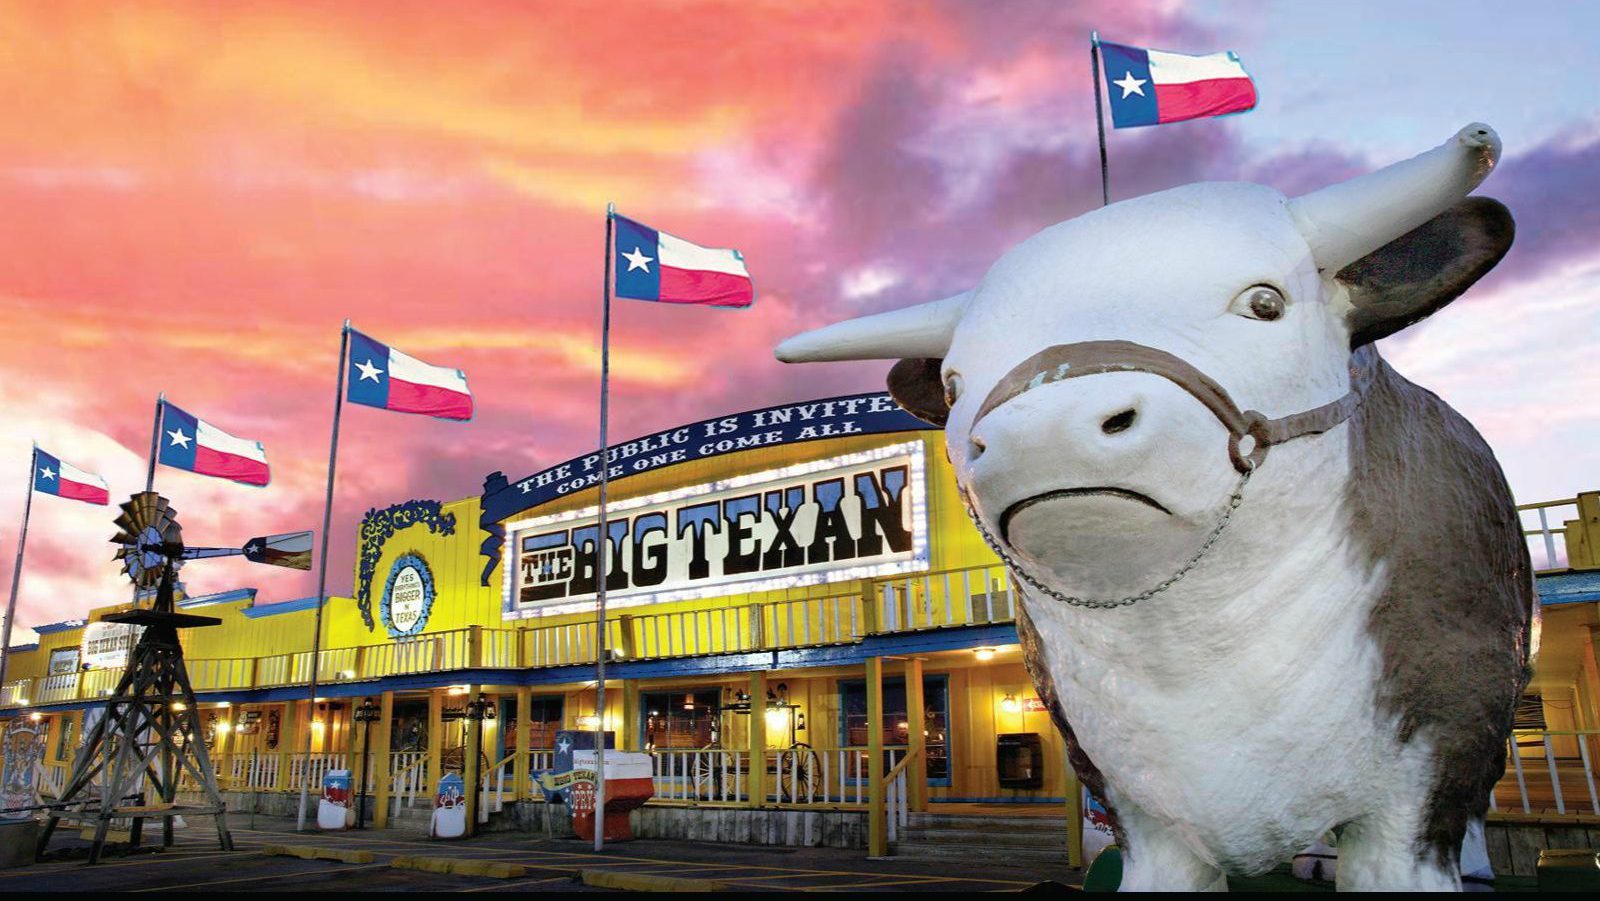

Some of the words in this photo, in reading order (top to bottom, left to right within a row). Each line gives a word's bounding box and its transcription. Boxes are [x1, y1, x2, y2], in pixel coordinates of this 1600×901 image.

[517, 463, 572, 494] THE
[582, 428, 689, 470] PUBLIC
[703, 416, 738, 438] IS
[752, 396, 903, 428] INVITE
[556, 464, 624, 494] COME
[632, 449, 686, 470] ONE
[699, 430, 783, 455] COME
[798, 421, 862, 440] ALL
[521, 545, 573, 584] THE
[569, 510, 669, 597] BIG
[677, 464, 912, 580] TEXAN
[395, 589, 420, 603] BIGGER
[400, 573, 414, 583] YES
[396, 610, 417, 623] TEXAS
